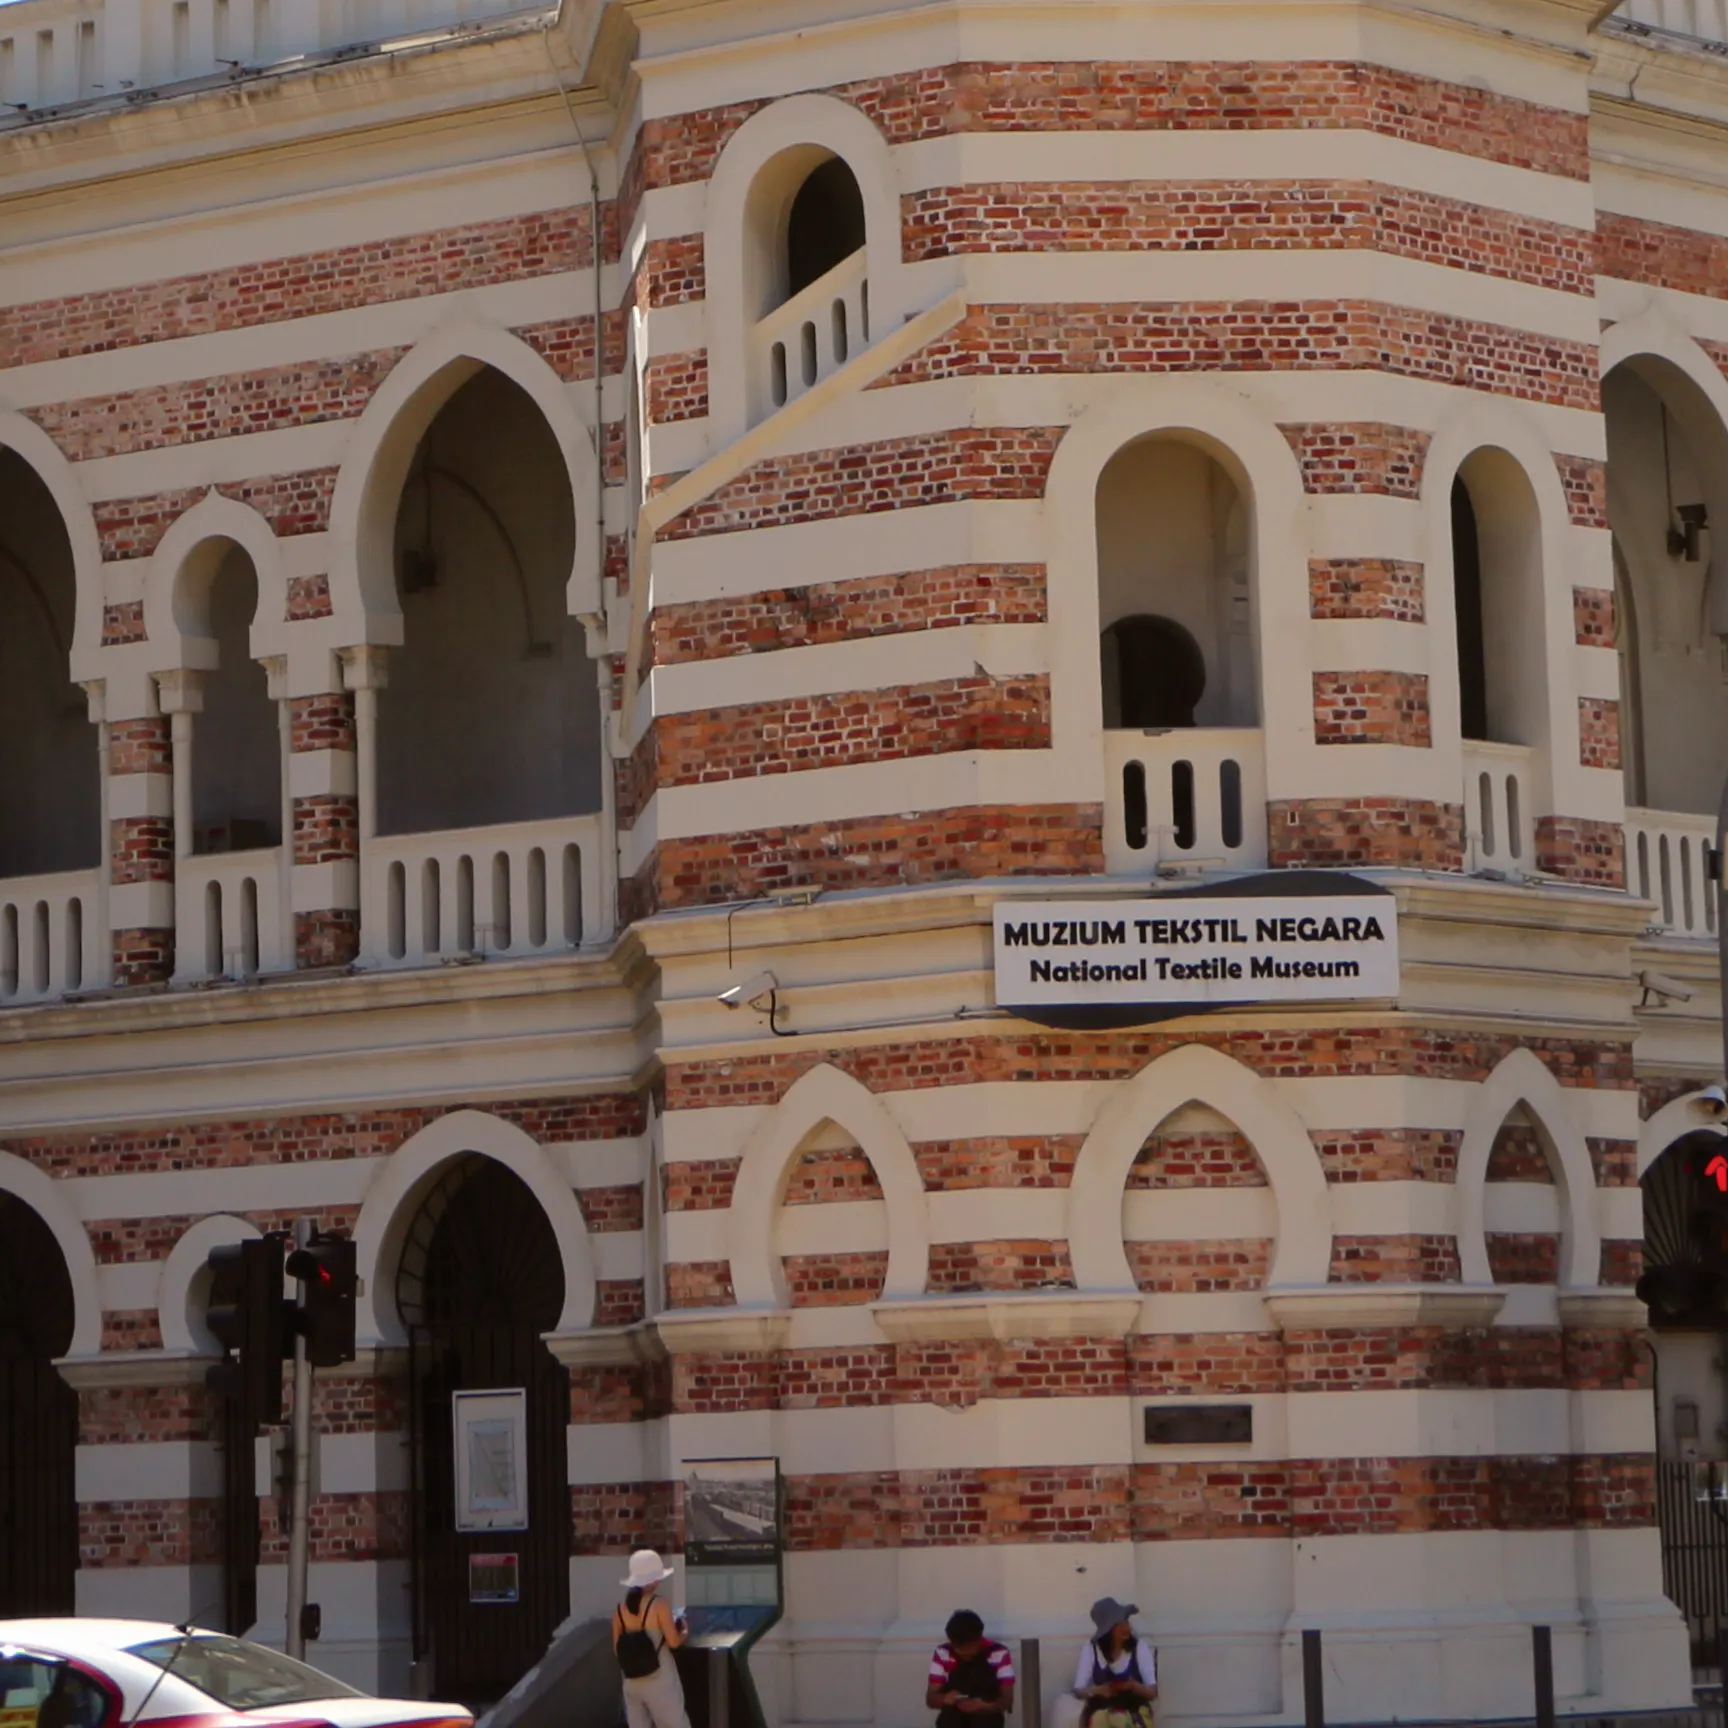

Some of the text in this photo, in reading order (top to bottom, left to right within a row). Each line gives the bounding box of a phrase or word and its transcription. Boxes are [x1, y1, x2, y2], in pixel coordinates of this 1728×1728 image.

[1004, 916, 1384, 947] MUZIUM TEKSTIL NEGARA
[1030, 956, 1360, 982] National Textile Museum
